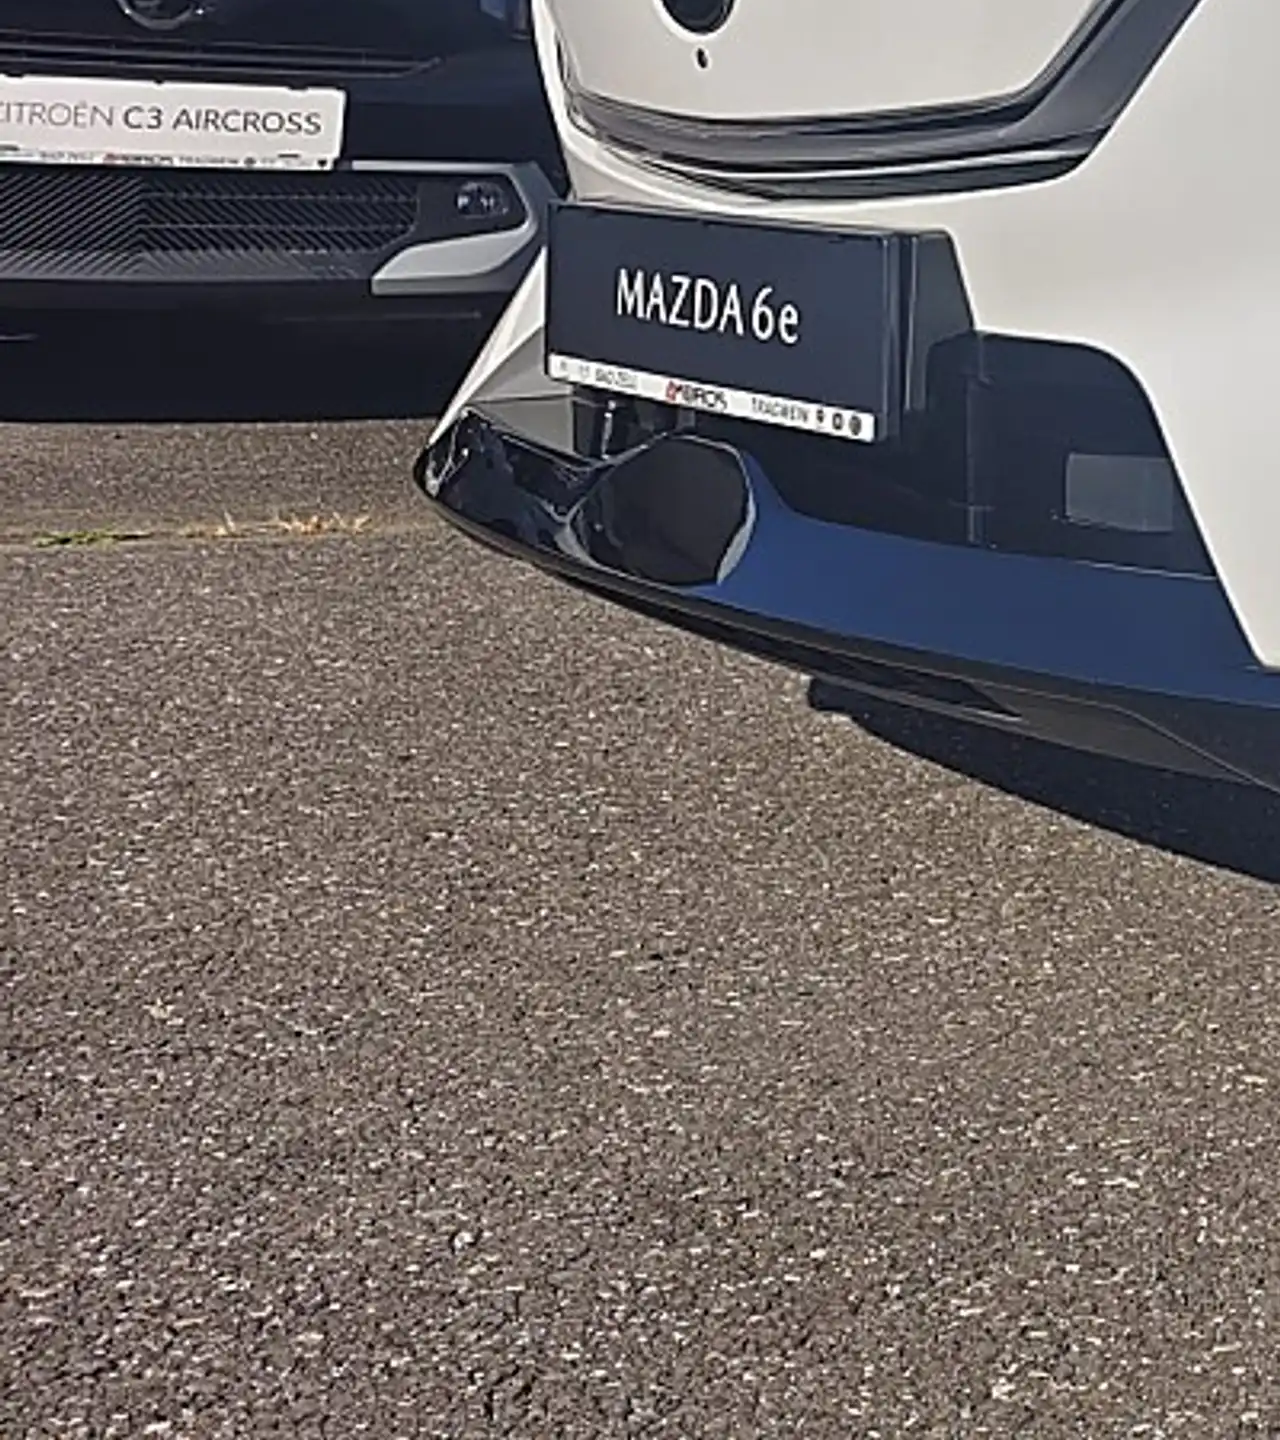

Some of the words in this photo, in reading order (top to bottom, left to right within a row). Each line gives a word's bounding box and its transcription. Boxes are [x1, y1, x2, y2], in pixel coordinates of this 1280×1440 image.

[123, 106, 164, 131] C3
[172, 109, 322, 136] AIRCROSS
[615, 267, 745, 336] MAZDA
[752, 286, 799, 344] 6e
